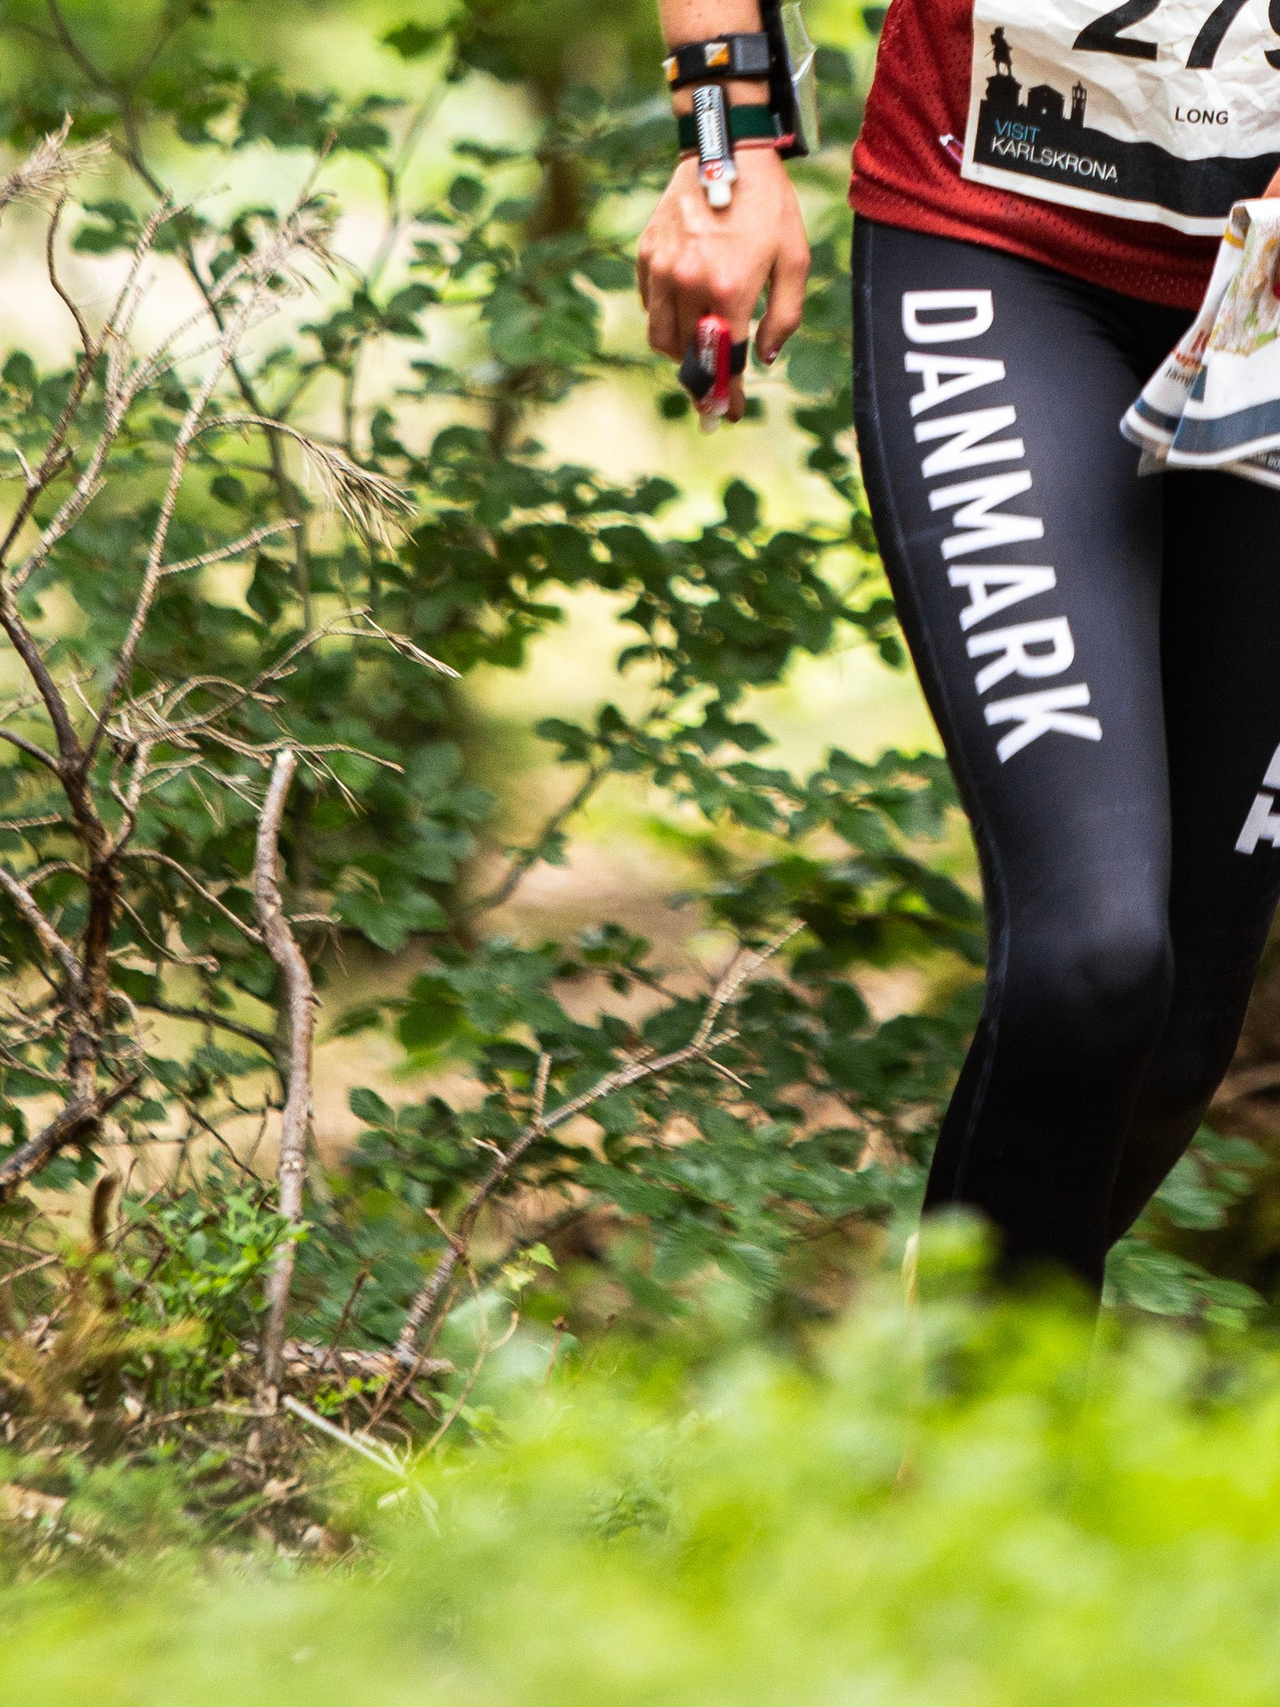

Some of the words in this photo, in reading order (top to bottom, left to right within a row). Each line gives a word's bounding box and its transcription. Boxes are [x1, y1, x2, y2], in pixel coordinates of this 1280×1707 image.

[994, 118, 1041, 143] VISIT
[1174, 106, 1229, 125] LONG
[990, 135, 1118, 183] KARLSKRONA
[901, 289, 1103, 764] DANMARK
